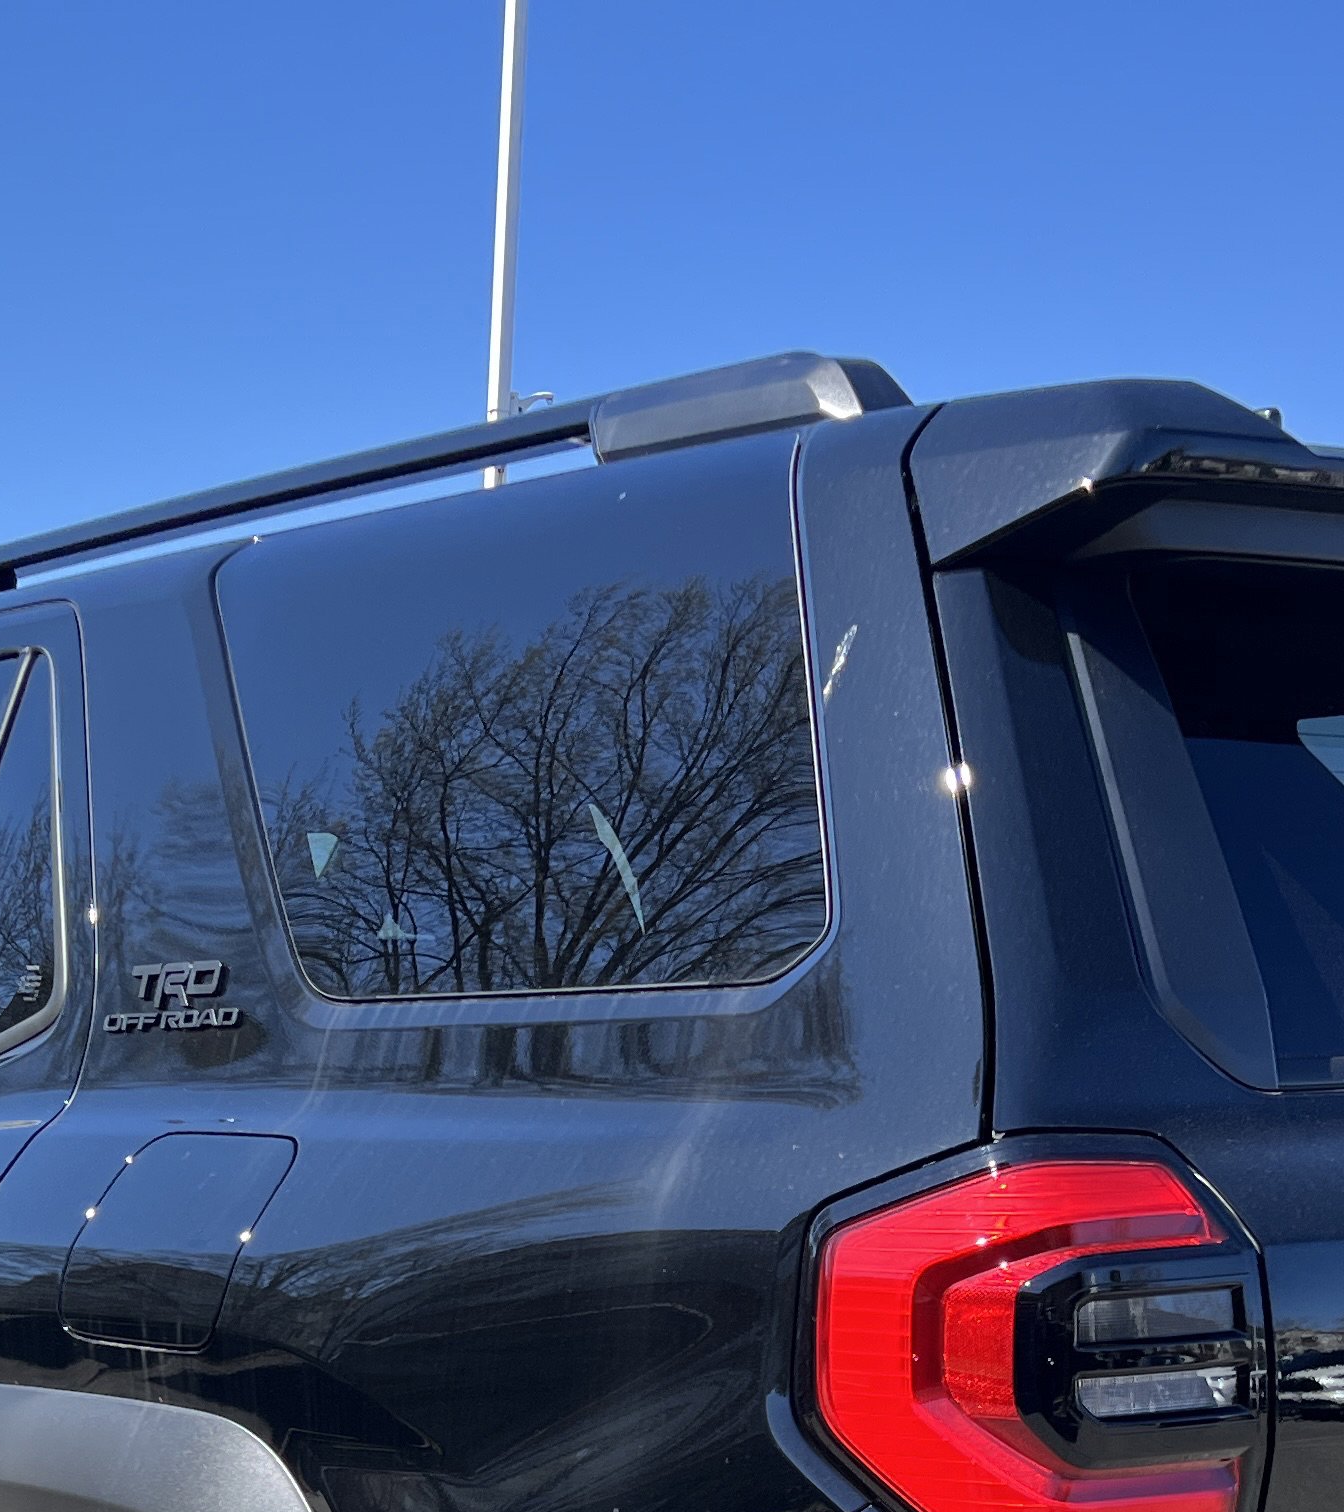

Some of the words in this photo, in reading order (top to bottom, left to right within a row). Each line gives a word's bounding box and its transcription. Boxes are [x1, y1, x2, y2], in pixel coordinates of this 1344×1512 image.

[132, 959, 227, 1008] TRD
[103, 1012, 157, 1032] OFF
[159, 1007, 241, 1030] ROAD
